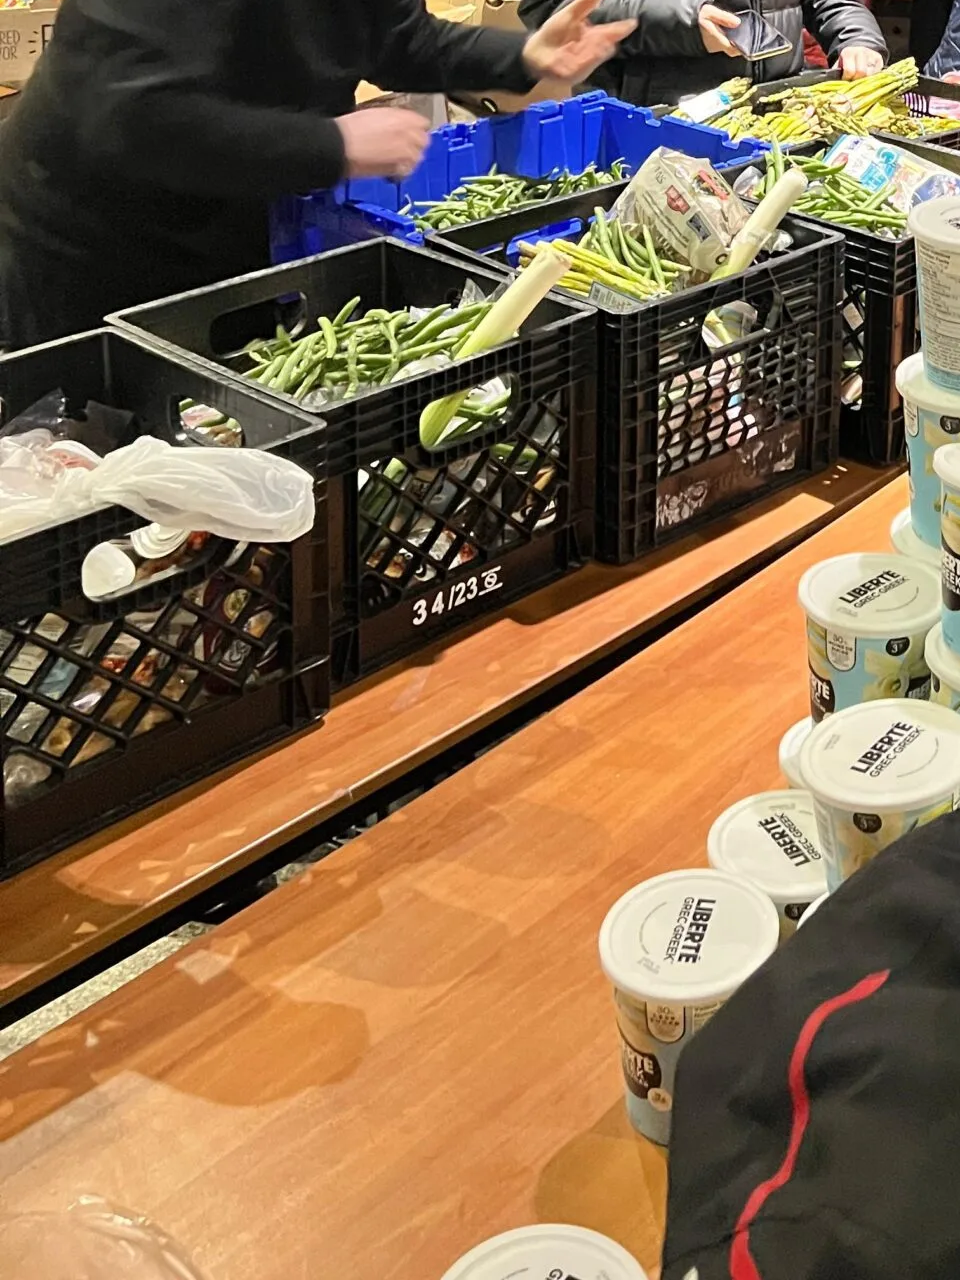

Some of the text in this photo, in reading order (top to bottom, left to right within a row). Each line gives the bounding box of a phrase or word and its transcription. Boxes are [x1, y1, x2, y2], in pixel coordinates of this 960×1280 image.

[839, 569, 902, 604] LIBERTÉ
[850, 721, 913, 774] LIBERTÉ
[758, 816, 811, 867] LIBERTÉ
[677, 898, 717, 964] LIBERTÉ
